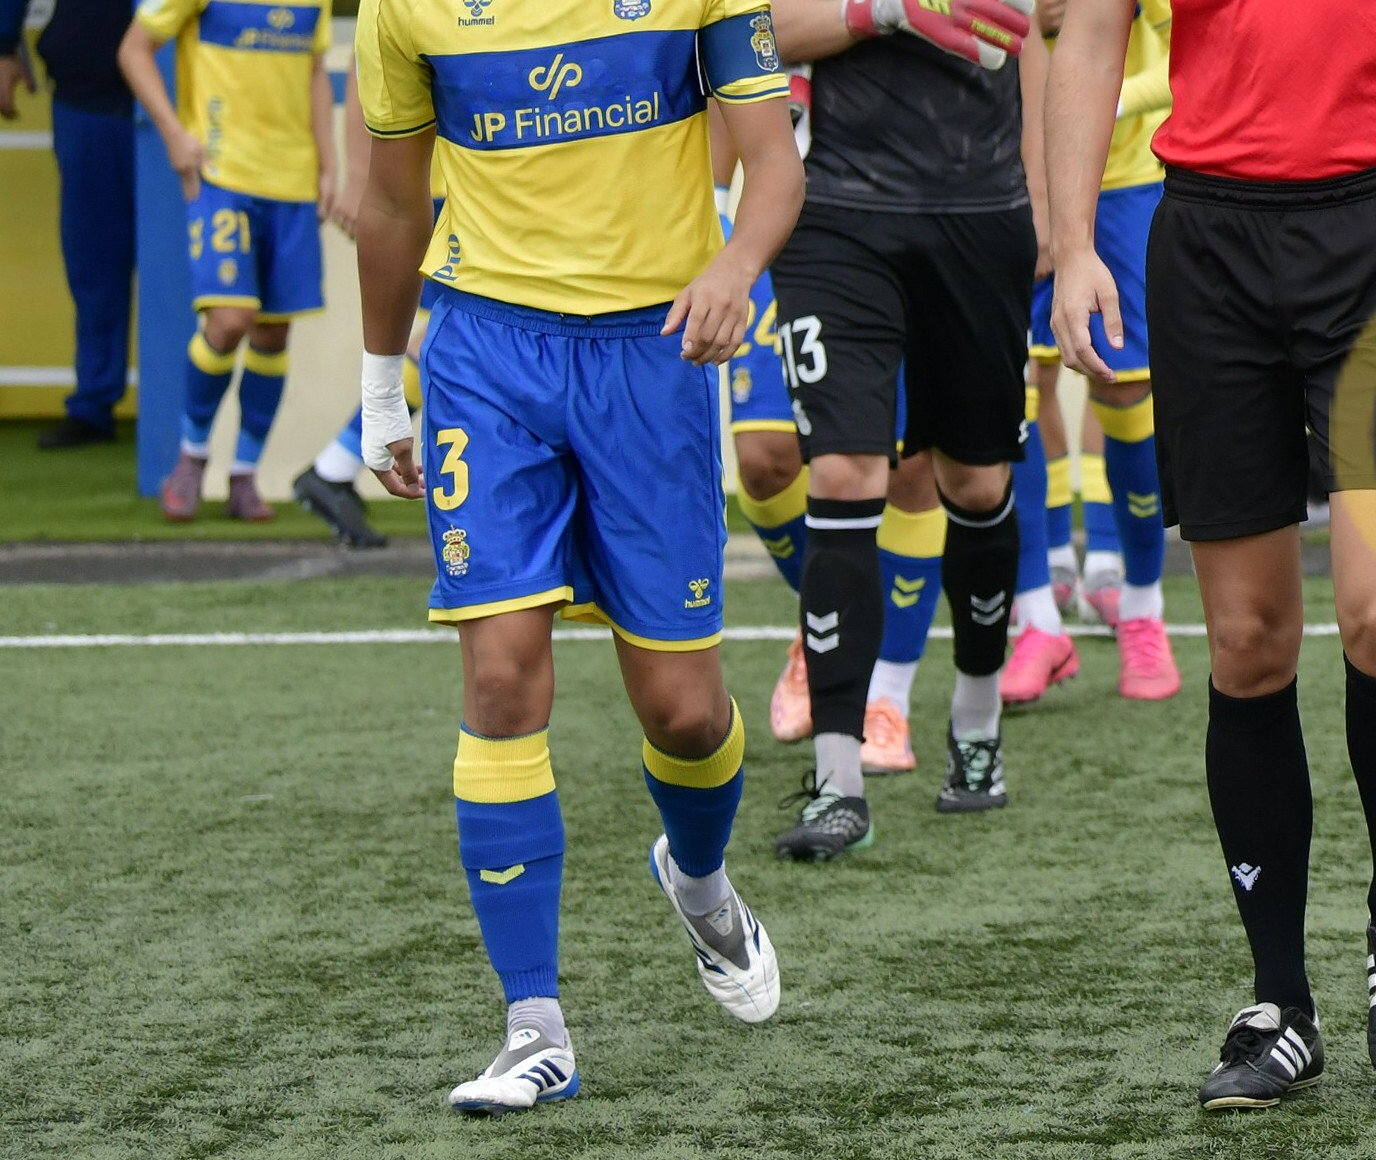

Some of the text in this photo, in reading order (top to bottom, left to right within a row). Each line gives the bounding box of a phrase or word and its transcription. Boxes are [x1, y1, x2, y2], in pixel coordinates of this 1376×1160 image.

[458, 14, 495, 27] hummel
[470, 91, 660, 142] JP Financial
[211, 208, 251, 254] 21
[780, 314, 828, 389] 13
[433, 427, 471, 512] 3
